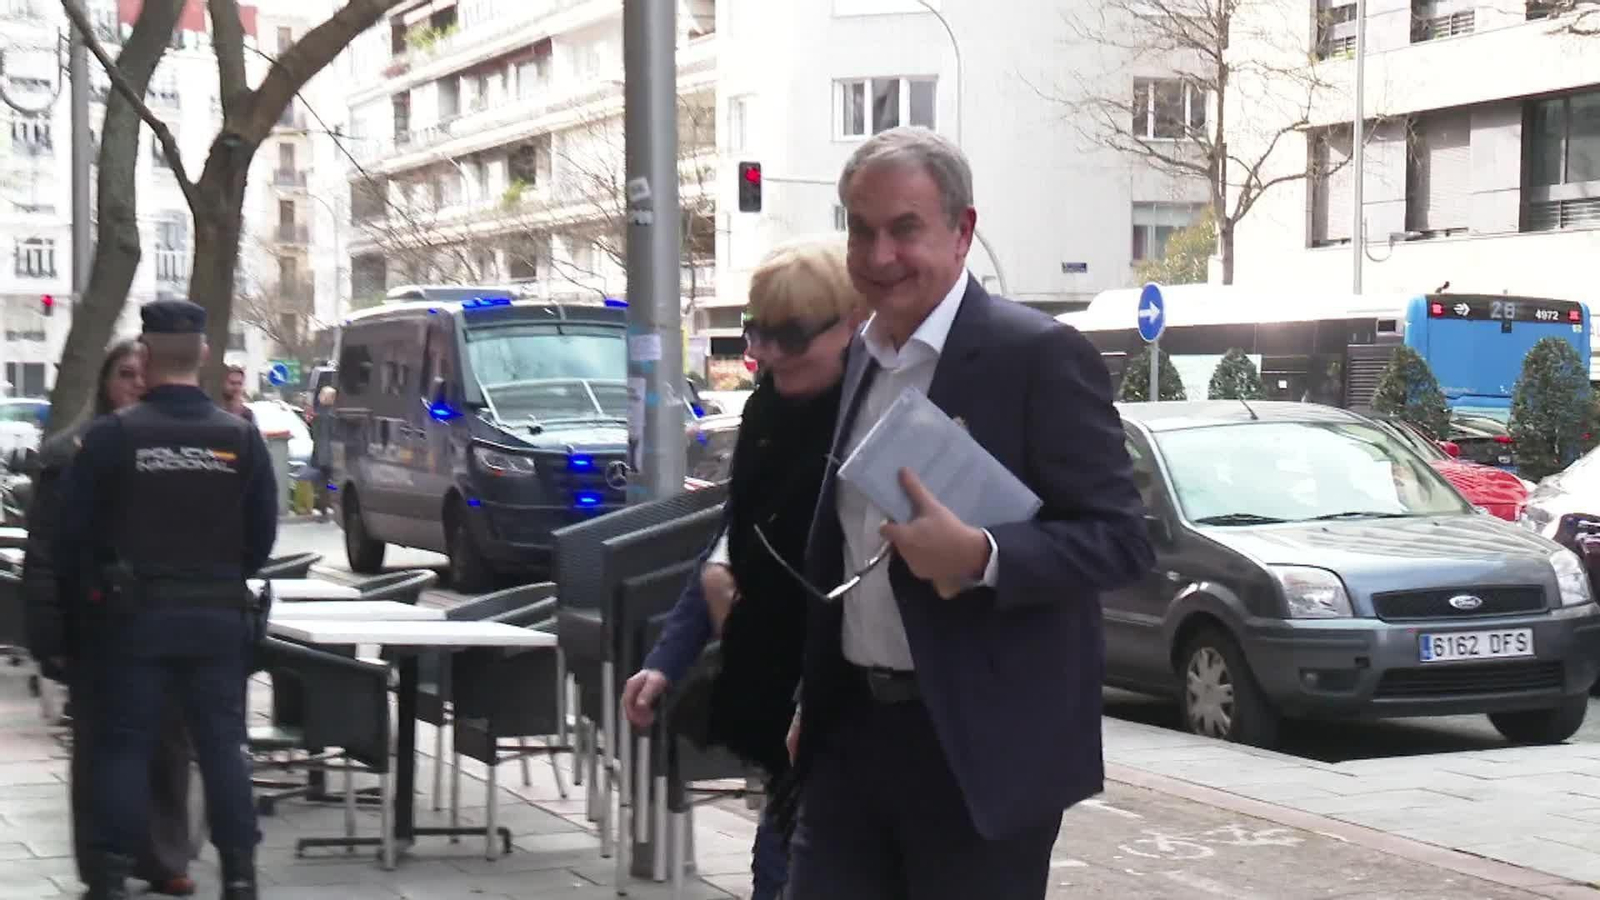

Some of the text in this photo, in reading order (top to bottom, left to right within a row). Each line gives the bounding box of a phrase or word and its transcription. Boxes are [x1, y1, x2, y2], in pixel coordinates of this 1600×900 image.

[1535, 309, 1559, 321] 4972
[1433, 632, 1527, 657] 6162 DFS
